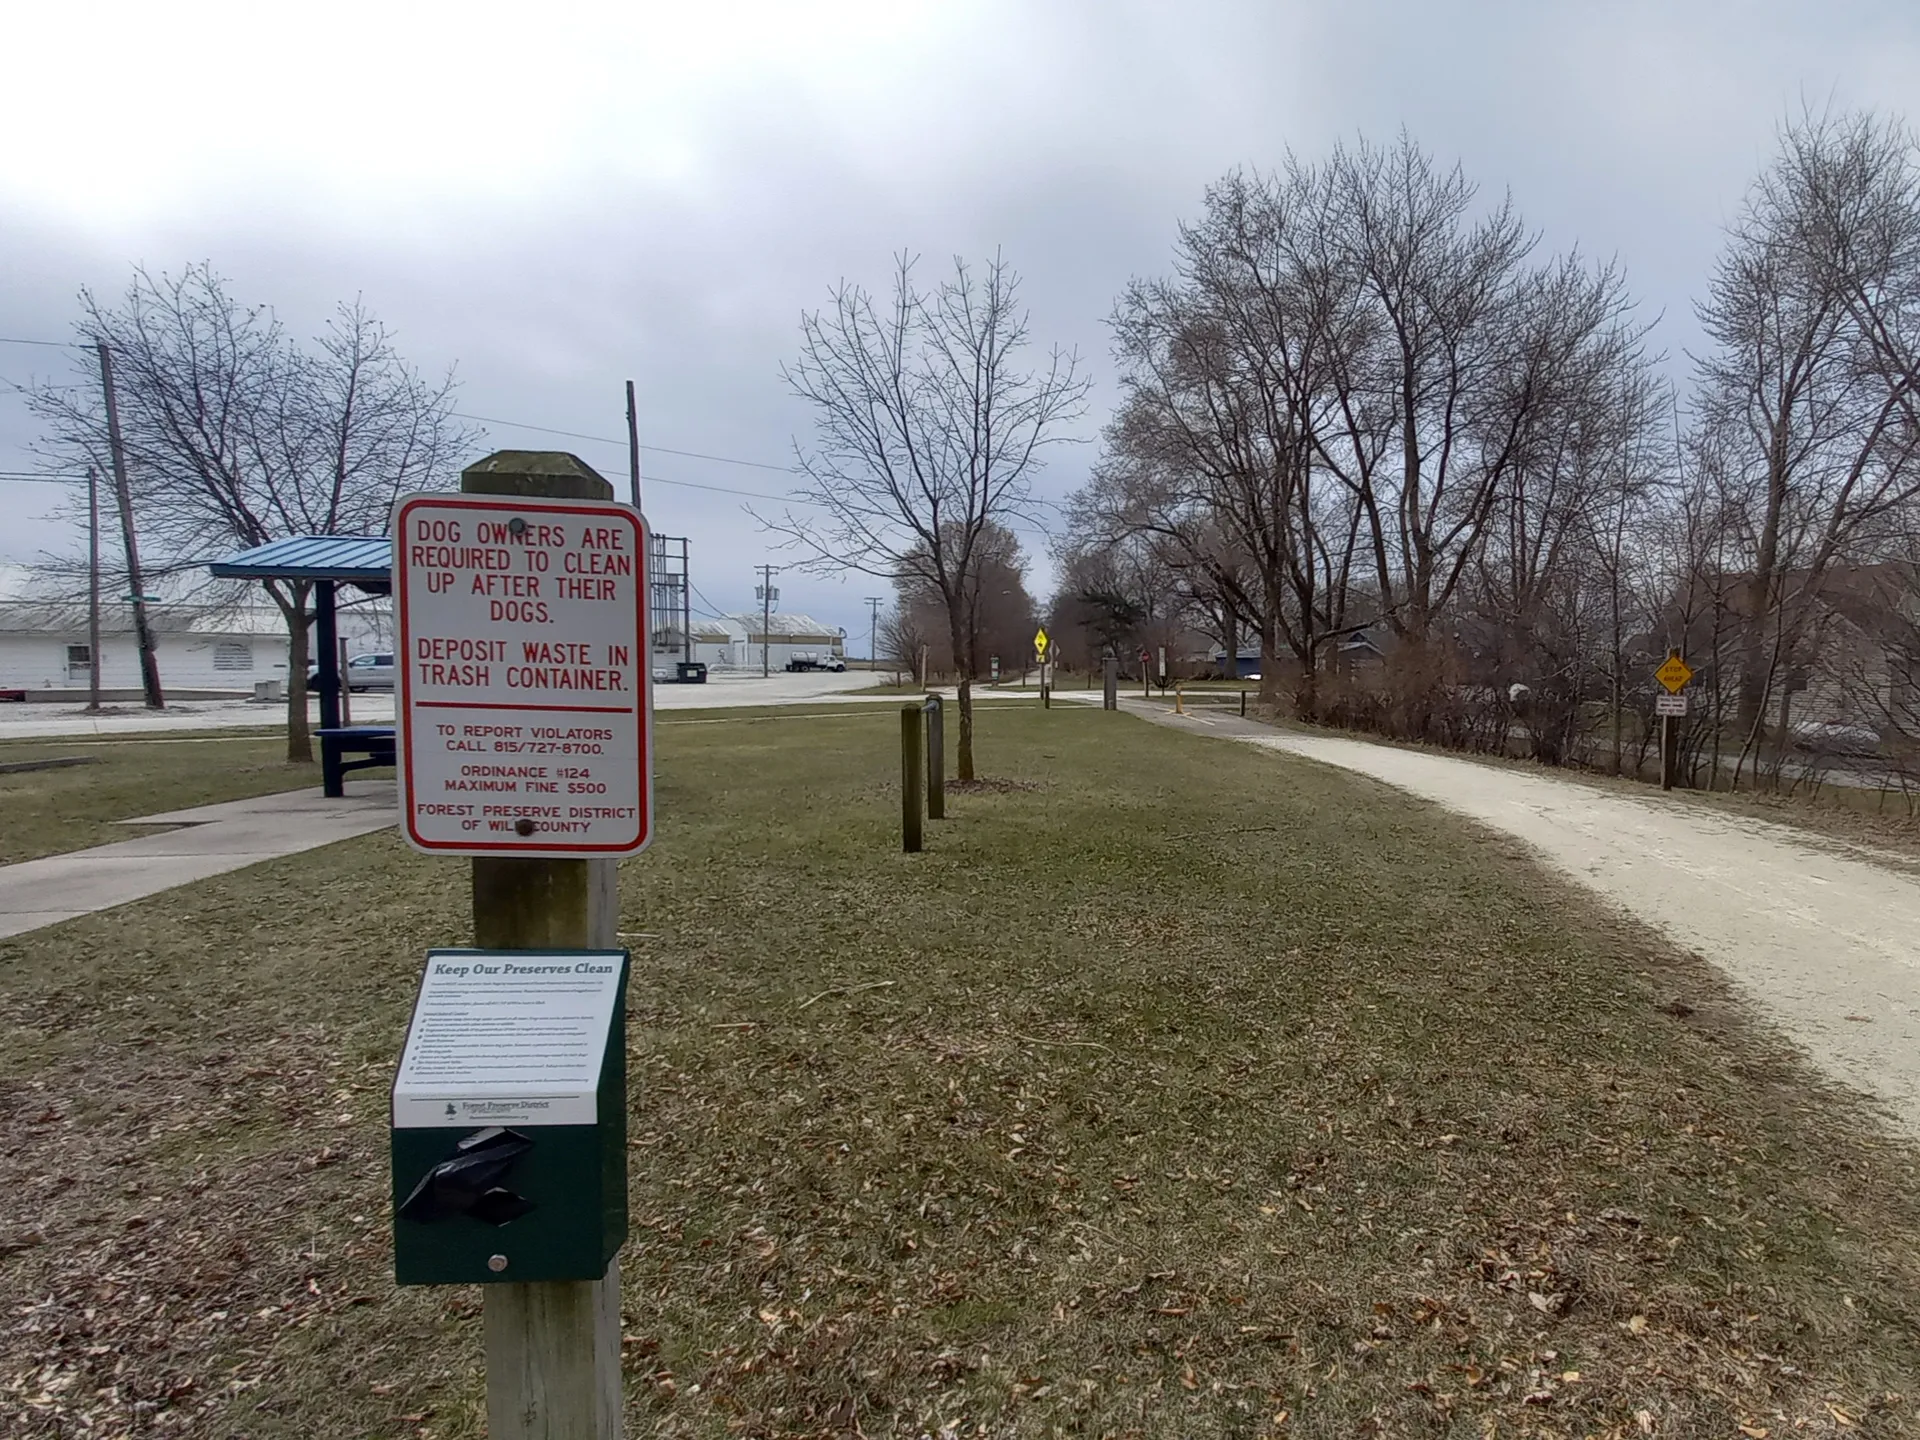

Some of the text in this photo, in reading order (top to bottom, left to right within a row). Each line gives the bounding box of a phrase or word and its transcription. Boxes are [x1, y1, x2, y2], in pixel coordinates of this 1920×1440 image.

[418, 520, 461, 543] DOG
[581, 529, 623, 550] ARE
[412, 546, 631, 576] REQUIRED TO CLEAN
[428, 572, 616, 600] UP AFTER THEIR
[491, 600, 554, 624] DOGS.
[418, 638, 628, 666] DEPOSIT WASTE IN
[419, 663, 628, 691] TRASH CONTAINER.
[437, 725, 612, 740] TO REPORT VIOLATORS
[446, 740, 604, 755] CALL 815/727-8700.
[461, 765, 590, 779] ORDINANCE #124
[445, 780, 606, 794] MAXIMUM FINE $500
[418, 804, 635, 819] FOREST PRESERVE DISTRICT
[462, 820, 481, 830] OF
[489, 820, 526, 833] WIL
[434, 963, 613, 978] Keep Our Preserves Clean
[521, 1101, 549, 1109] District
